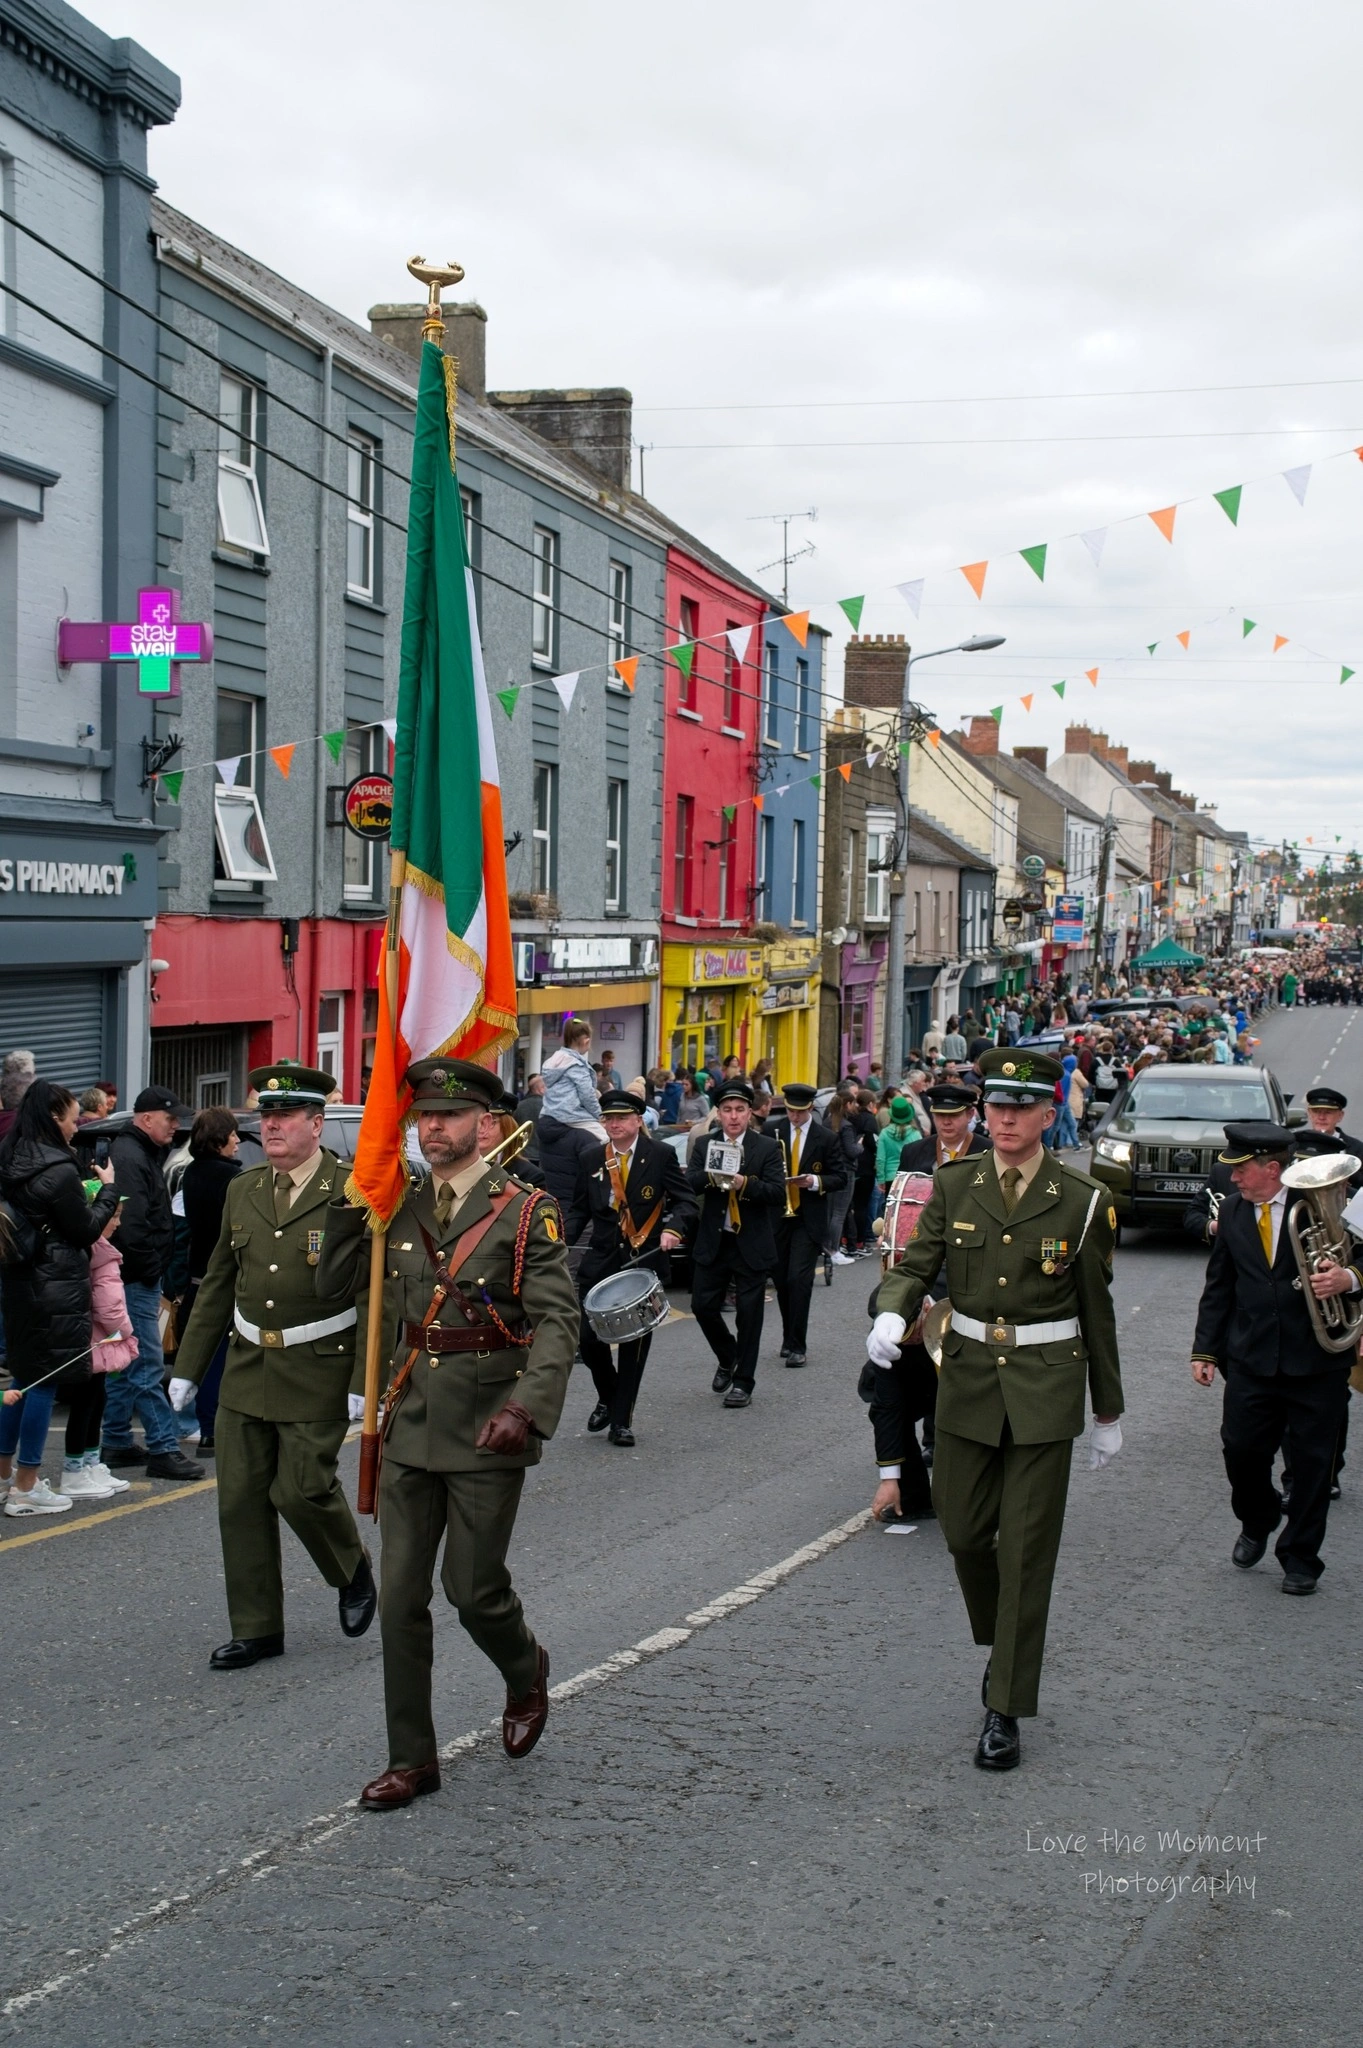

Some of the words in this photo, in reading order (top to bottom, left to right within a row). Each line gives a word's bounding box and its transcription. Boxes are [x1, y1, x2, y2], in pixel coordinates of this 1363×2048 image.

[131, 622, 177, 641] stay
[131, 641, 176, 657] well
[354, 784, 394, 797] APACHE
[16, 860, 125, 895] PHARMACY
